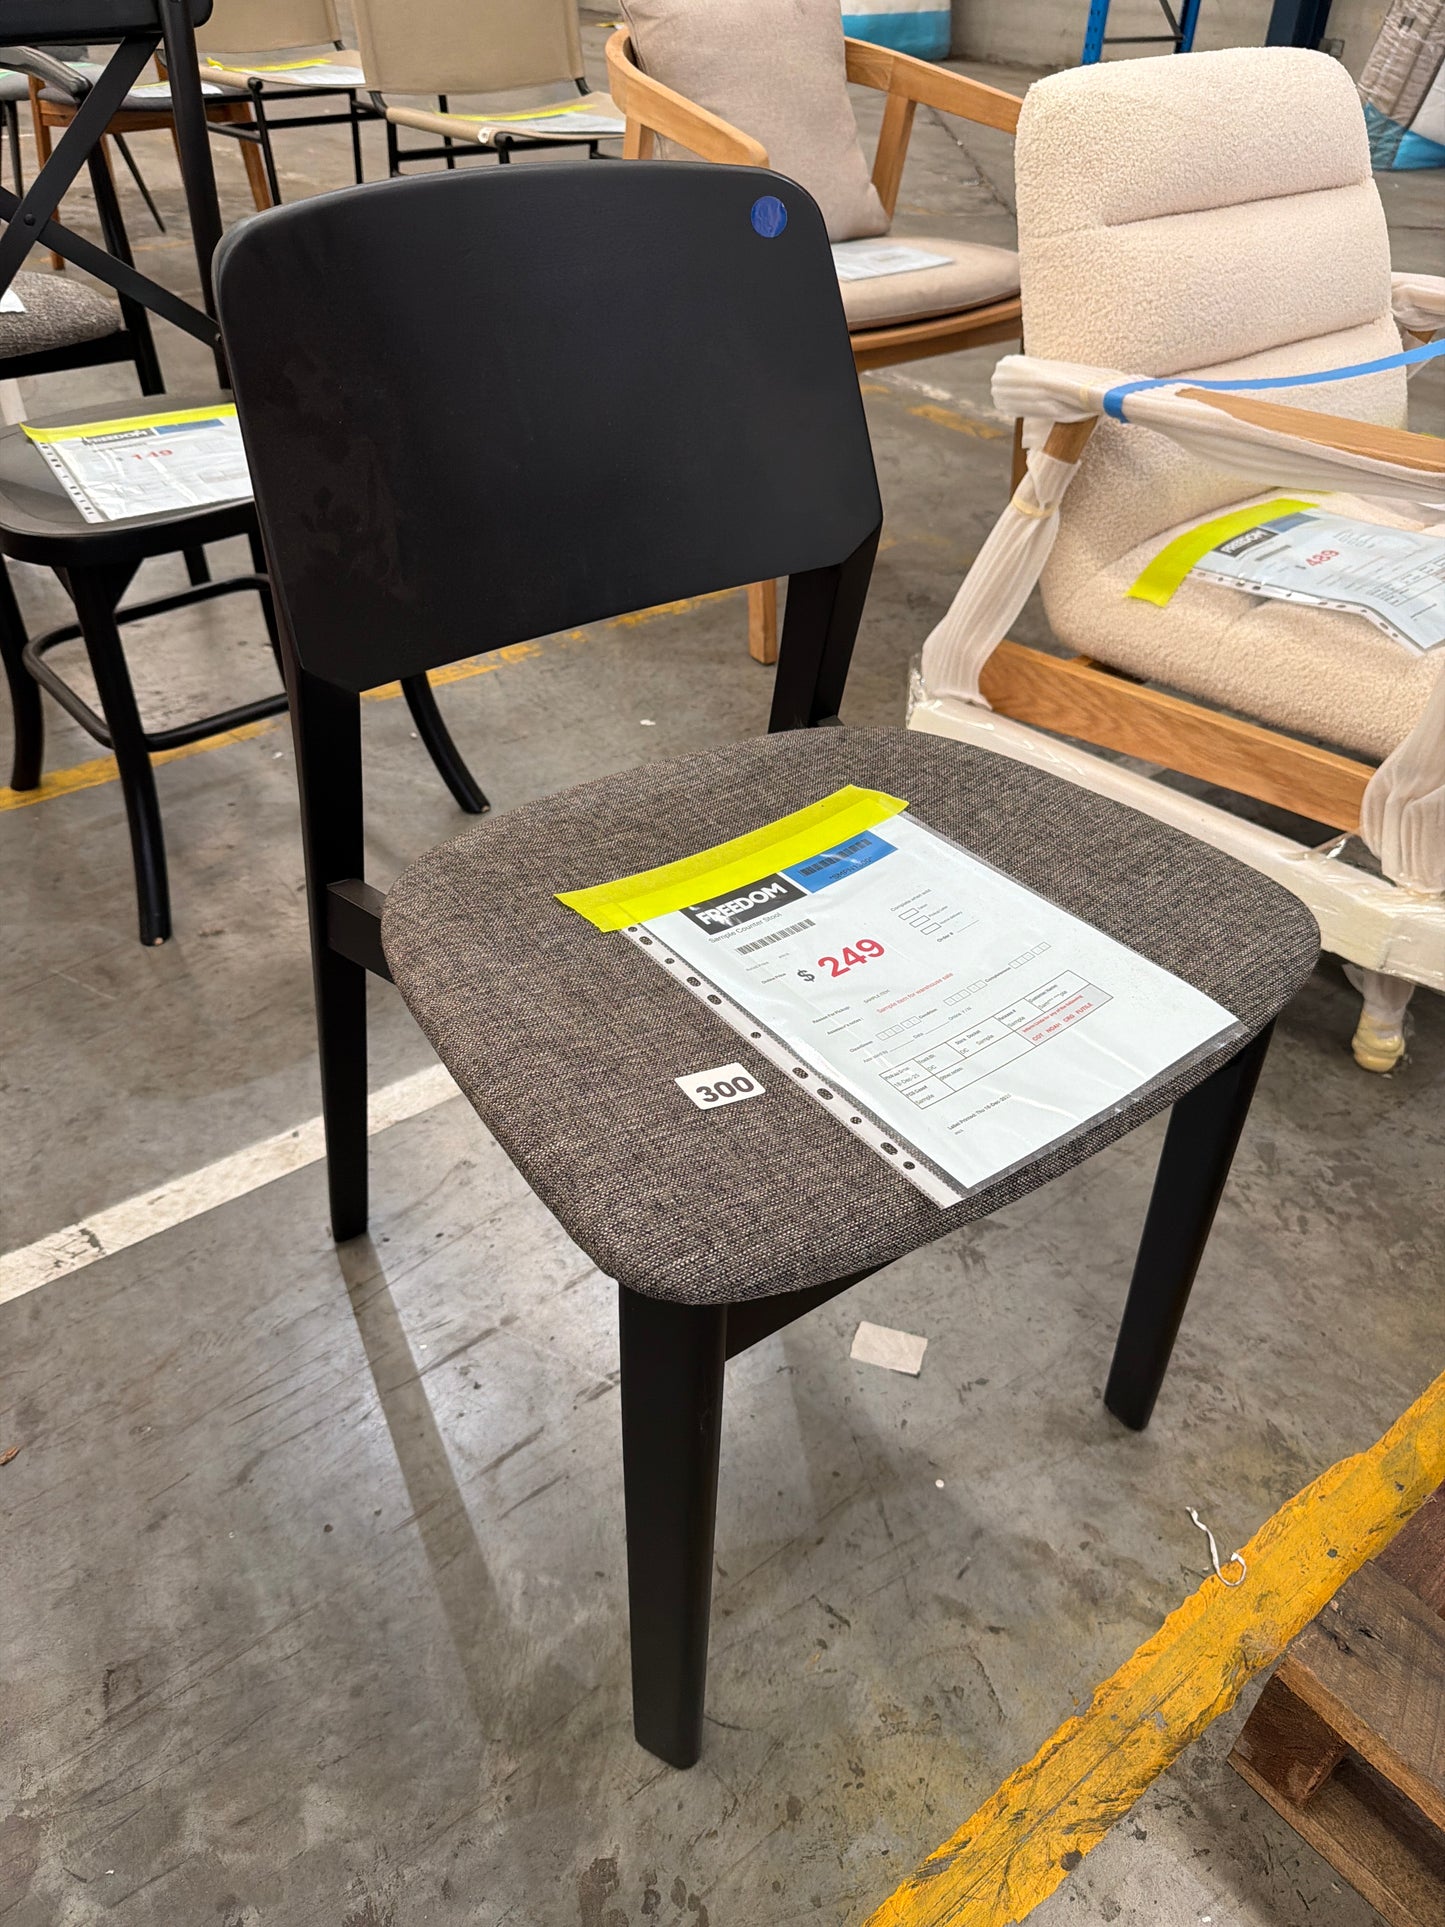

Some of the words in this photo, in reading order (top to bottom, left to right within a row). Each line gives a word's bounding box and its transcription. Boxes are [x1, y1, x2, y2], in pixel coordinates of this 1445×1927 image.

[1306, 549, 1340, 567] 489
[695, 882, 788, 926] FREEDOM
[708, 931, 736, 943] Sample
[735, 920, 763, 933] Counter
[762, 912, 782, 922] Stool
[797, 969, 815, 982] $
[818, 939, 884, 977] 249
[876, 1002, 897, 1013] Sample
[895, 996, 909, 1004] item
[915, 978, 942, 994] warehouse
[941, 972, 953, 980] sale
[1006, 1016, 1025, 1028] Sample
[1045, 1022, 1061, 1033] NOAH
[1075, 1002, 1093, 1014] FUTILE
[975, 1034, 994, 1045] Sample
[696, 1077, 754, 1102] 300
[914, 1094, 935, 1105] Sample
[946, 1121, 961, 1130] Label
